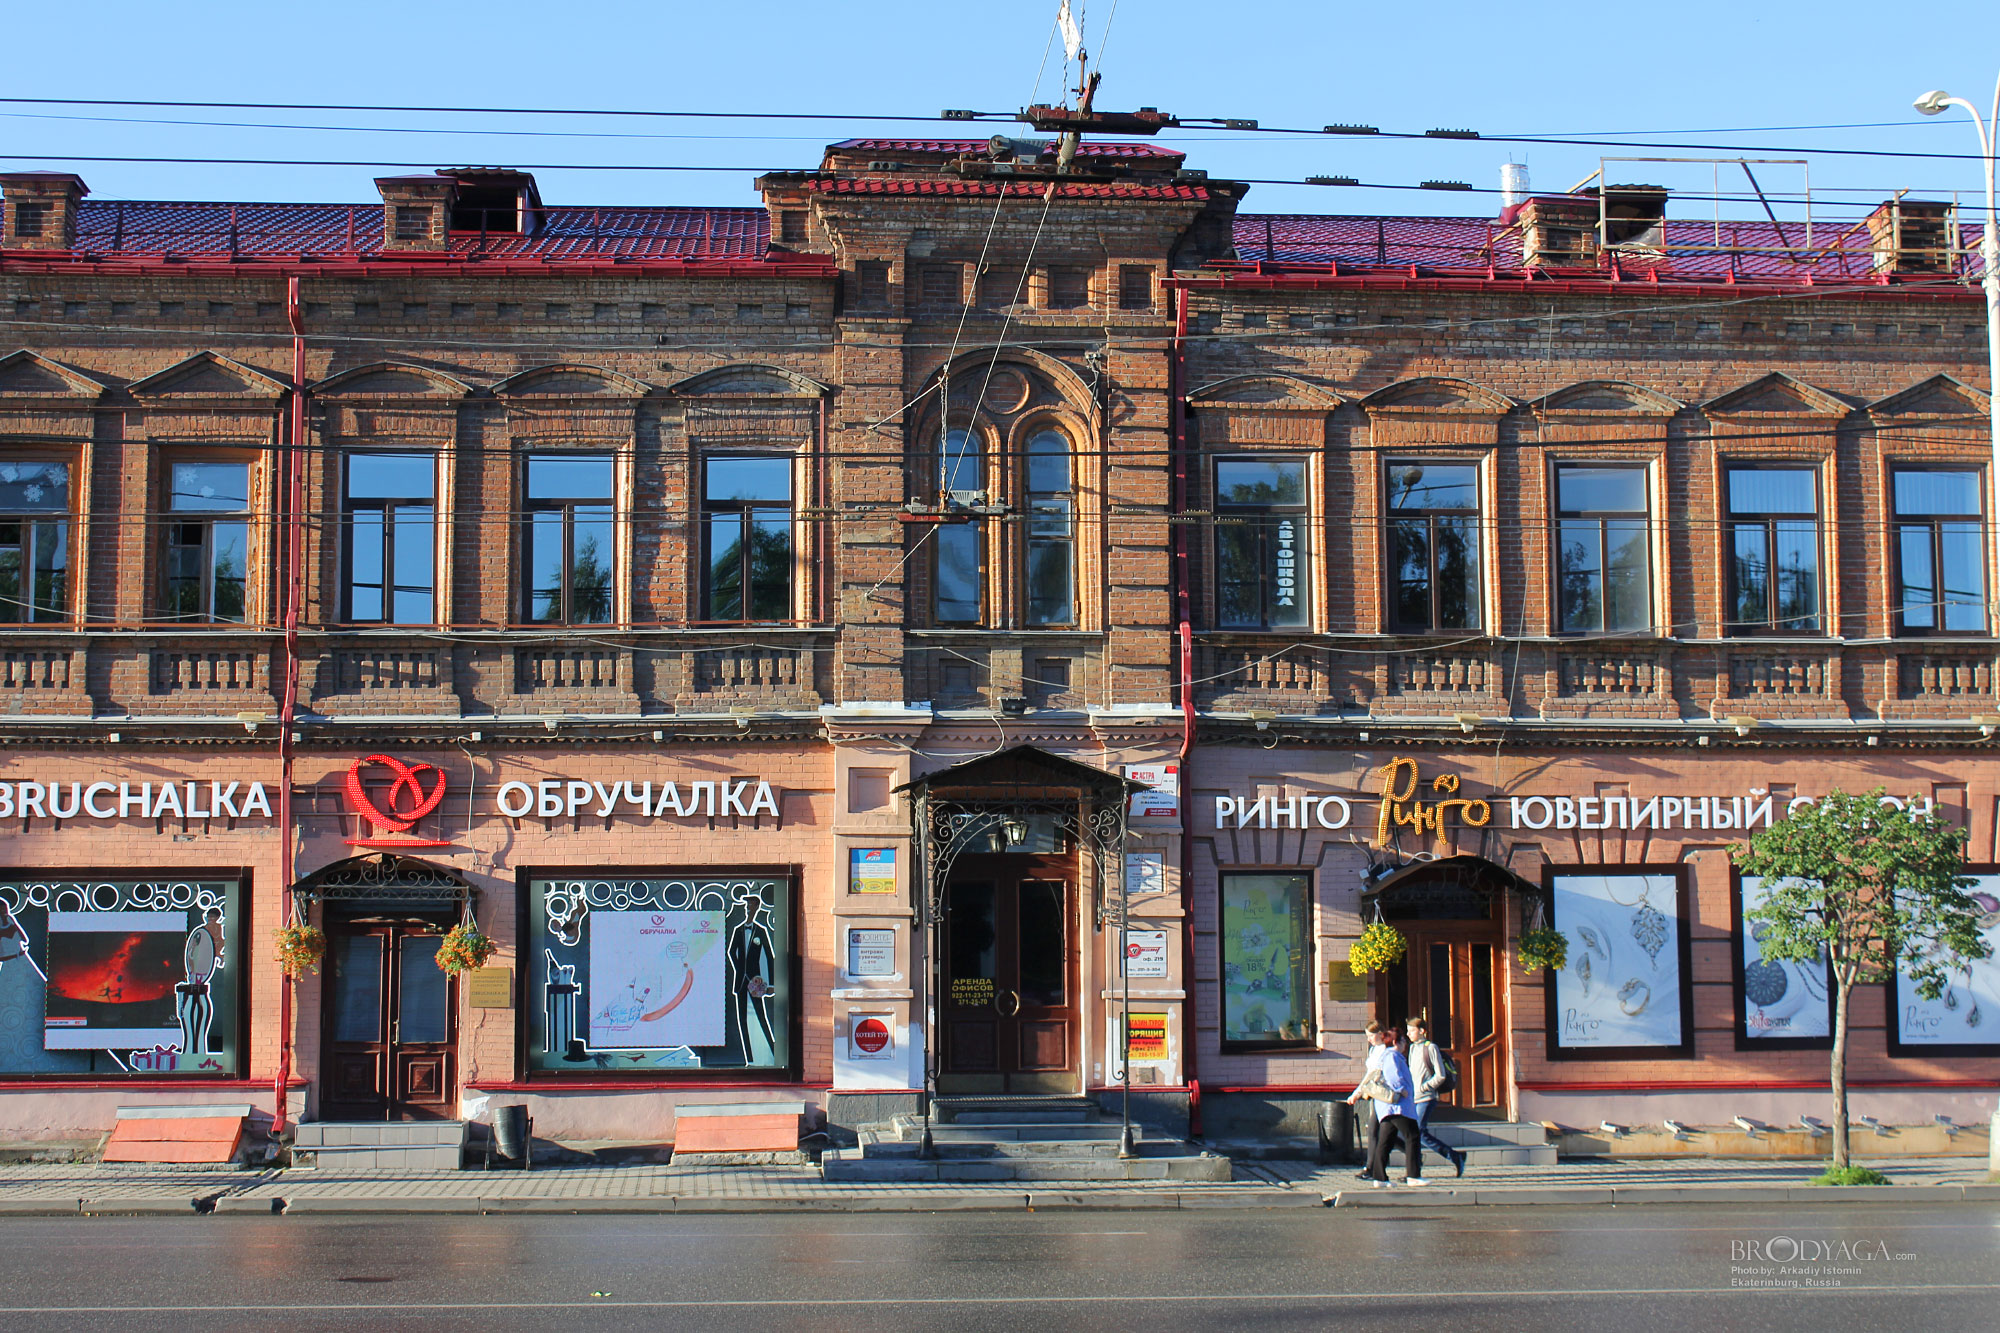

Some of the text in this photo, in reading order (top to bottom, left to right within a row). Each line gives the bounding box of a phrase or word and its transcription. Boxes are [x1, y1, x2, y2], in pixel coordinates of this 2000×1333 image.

[1276, 520, 1295, 606] АВТОШКОЛА
[1139, 771, 1155, 780] АСТРА
[496, 780, 780, 818] ОБРУЧАЛКА
[1215, 795, 1351, 831] РИНГО
[1378, 756, 1491, 846] Ринго
[1510, 787, 1773, 831] ЮВЕЛИРНЫЙ
